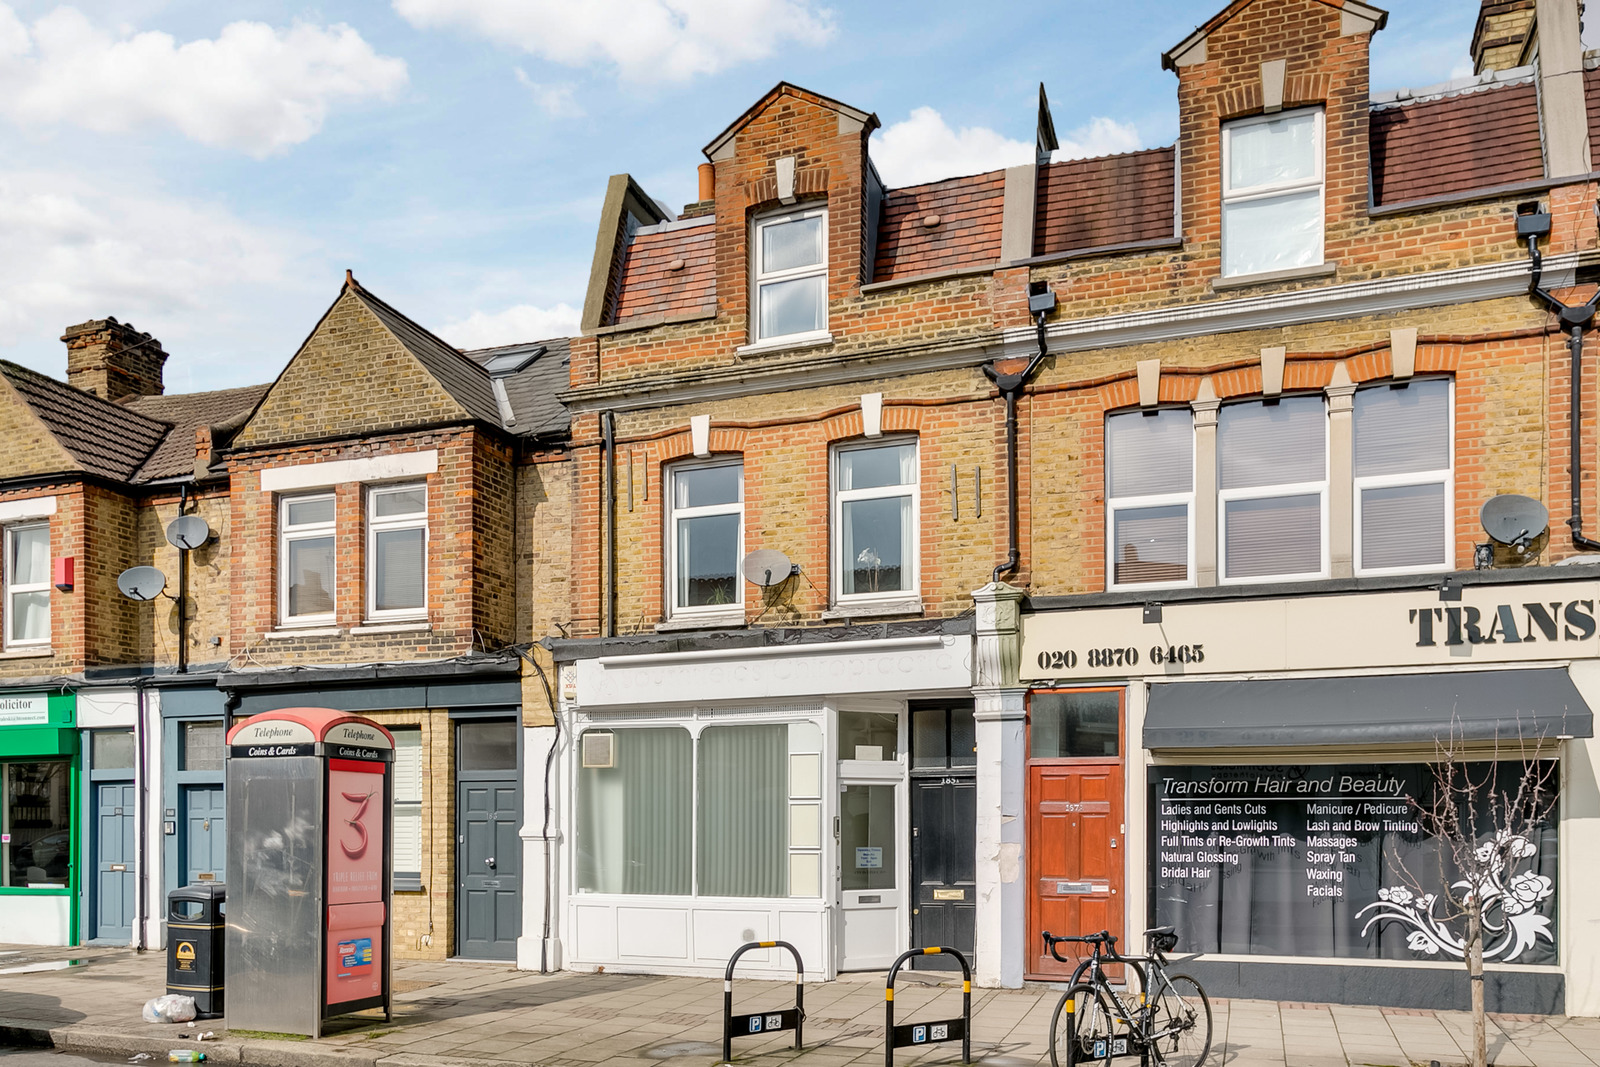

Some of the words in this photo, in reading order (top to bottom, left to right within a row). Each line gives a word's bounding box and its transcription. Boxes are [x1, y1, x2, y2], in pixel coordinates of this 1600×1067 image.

[1409, 600, 1600, 647] TRANS
[1038, 650, 1077, 670] 020
[1088, 647, 1138, 668] 8870
[1150, 644, 1204, 665] 6465
[0, 699, 32, 710] olicitor
[254, 727, 293, 738] Telephone
[343, 728, 375, 741] Telephone
[248, 747, 267, 756] Coins
[268, 747, 275, 756] &
[276, 746, 296, 755] Cards
[339, 747, 355, 757] Coins
[356, 749, 361, 757] &
[362, 749, 378, 759] Cards
[1161, 777, 1248, 794] Transform
[1254, 776, 1291, 793] Hair
[1297, 776, 1333, 793] and
[1338, 776, 1406, 797] Beauty
[1161, 804, 1191, 815] Ladies
[1194, 803, 1211, 815] and
[1214, 803, 1241, 814] Gents
[1244, 803, 1266, 814] Cuts
[1306, 803, 1353, 814] Manicure
[1355, 803, 1361, 815] /
[1363, 803, 1408, 814] Pedicure
[1161, 820, 1209, 833] Highlights
[1211, 820, 1229, 831] and
[1232, 819, 1278, 833] Lowlights
[1306, 820, 1330, 831] Lash
[1332, 820, 1351, 831] and
[1354, 820, 1380, 831] Brow
[1382, 819, 1418, 833] Tinting
[1161, 835, 1178, 846] Full
[1181, 835, 1204, 847] Tints
[1206, 837, 1217, 847] or
[1218, 835, 1270, 847] Re-Growth
[1272, 835, 1296, 847] Tints
[1306, 836, 1357, 849] Massages
[1161, 852, 1194, 862] Natural
[1196, 851, 1239, 865] Glossing
[1306, 851, 1335, 865] Spray
[1338, 851, 1356, 863] Tan
[1161, 866, 1188, 878] Bridal
[1191, 867, 1211, 878] Hair
[1306, 868, 1343, 882] Waxing
[1306, 885, 1342, 896] Facials
